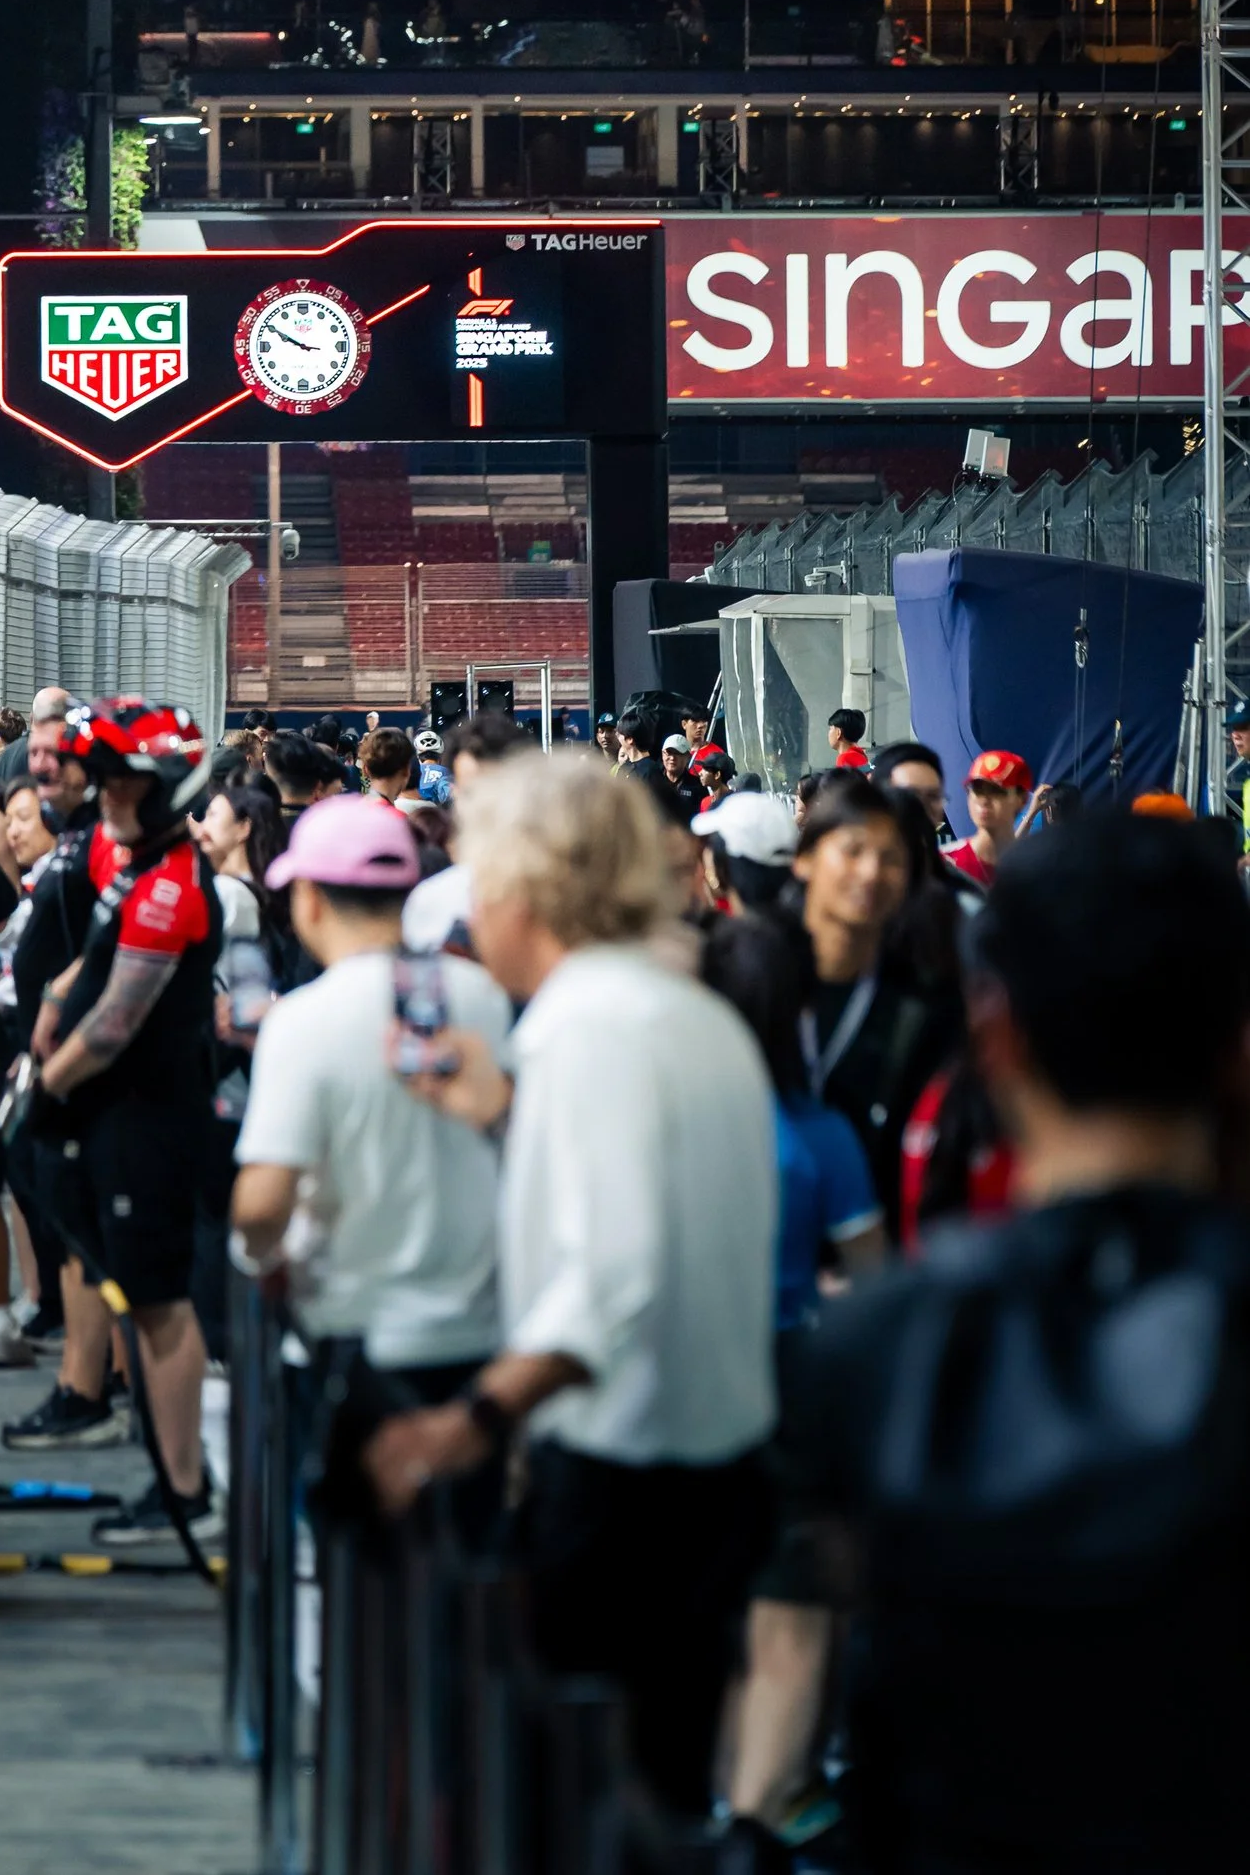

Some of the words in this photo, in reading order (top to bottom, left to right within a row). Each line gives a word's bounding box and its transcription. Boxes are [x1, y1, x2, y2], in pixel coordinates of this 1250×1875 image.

[531, 233, 648, 251] TAGHeuer
[54, 305, 174, 341] TAG
[456, 331, 547, 344] SINGAPORE
[456, 342, 514, 356] GRAND
[514, 342, 554, 355] PRIX
[456, 357, 488, 369] 2025
[52, 352, 178, 409] HEUER
